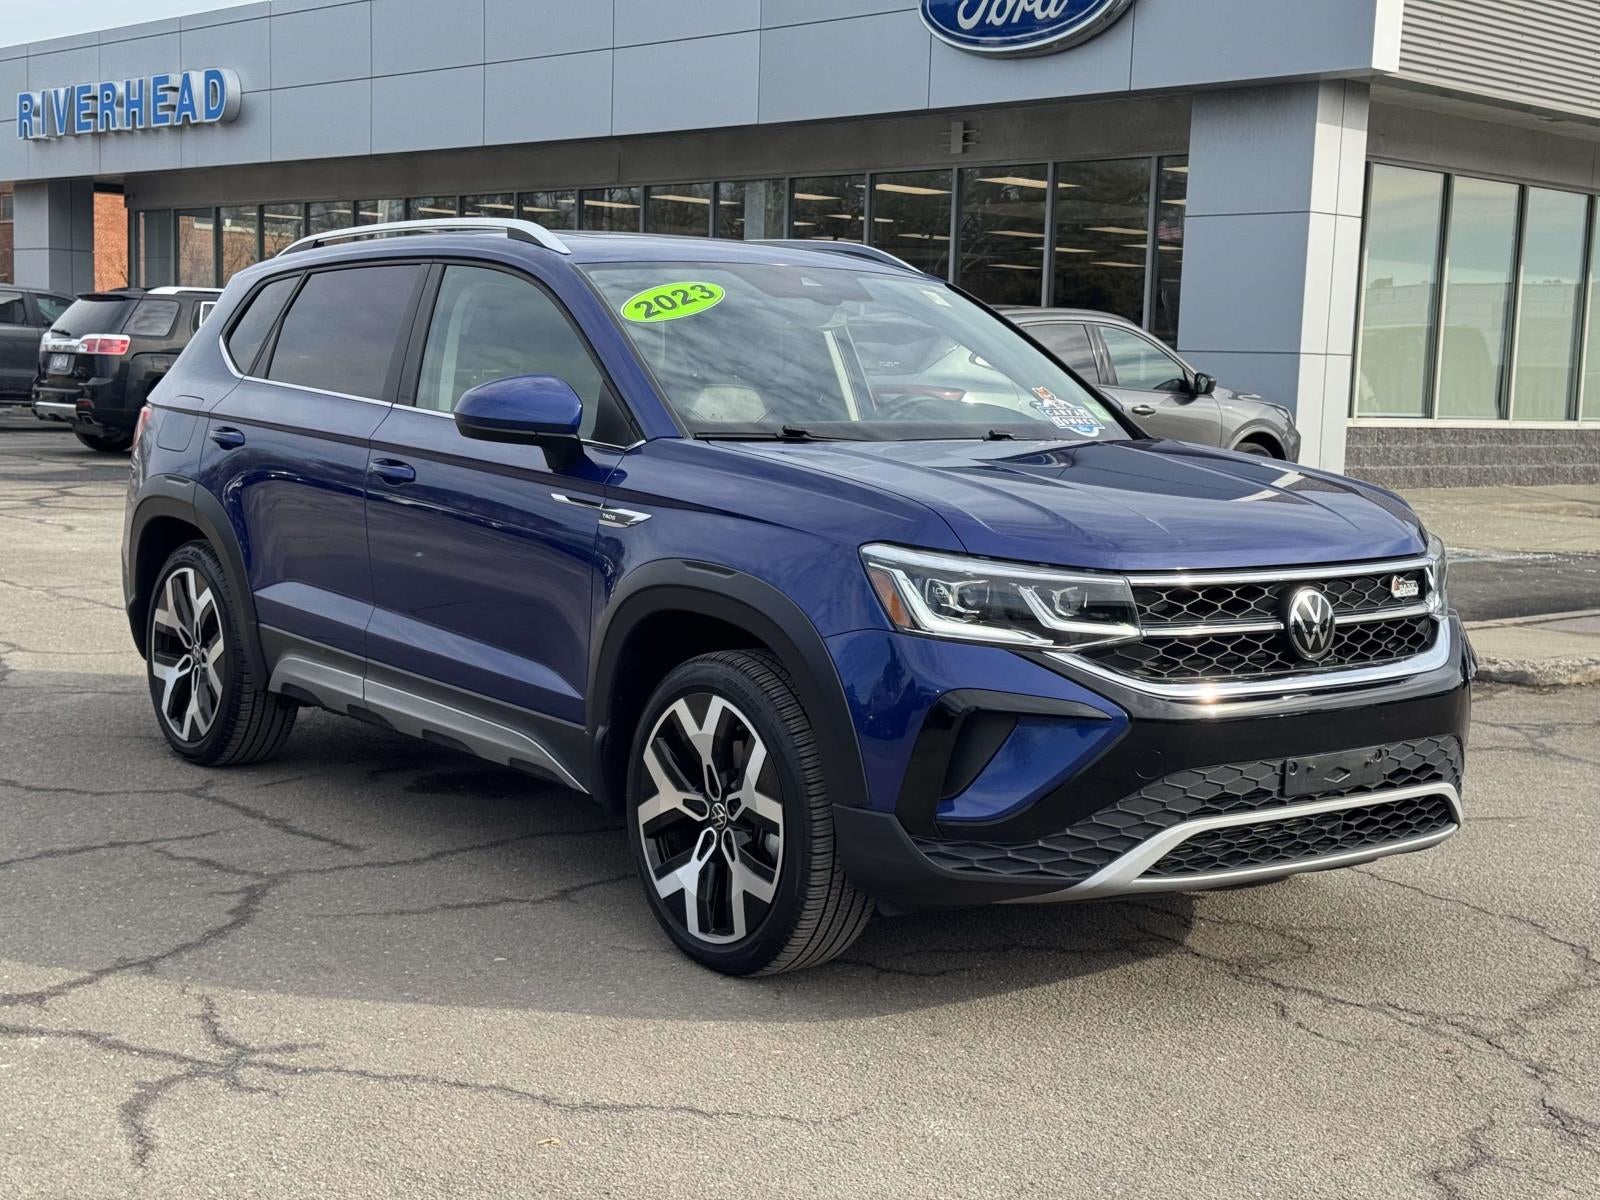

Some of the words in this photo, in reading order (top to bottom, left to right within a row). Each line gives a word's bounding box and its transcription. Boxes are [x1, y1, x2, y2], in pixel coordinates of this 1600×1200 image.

[957, 0, 1068, 30] or
[17, 68, 227, 140] RIVERHEAD
[634, 285, 715, 319] 2023
[603, 512, 616, 520] TAOS
